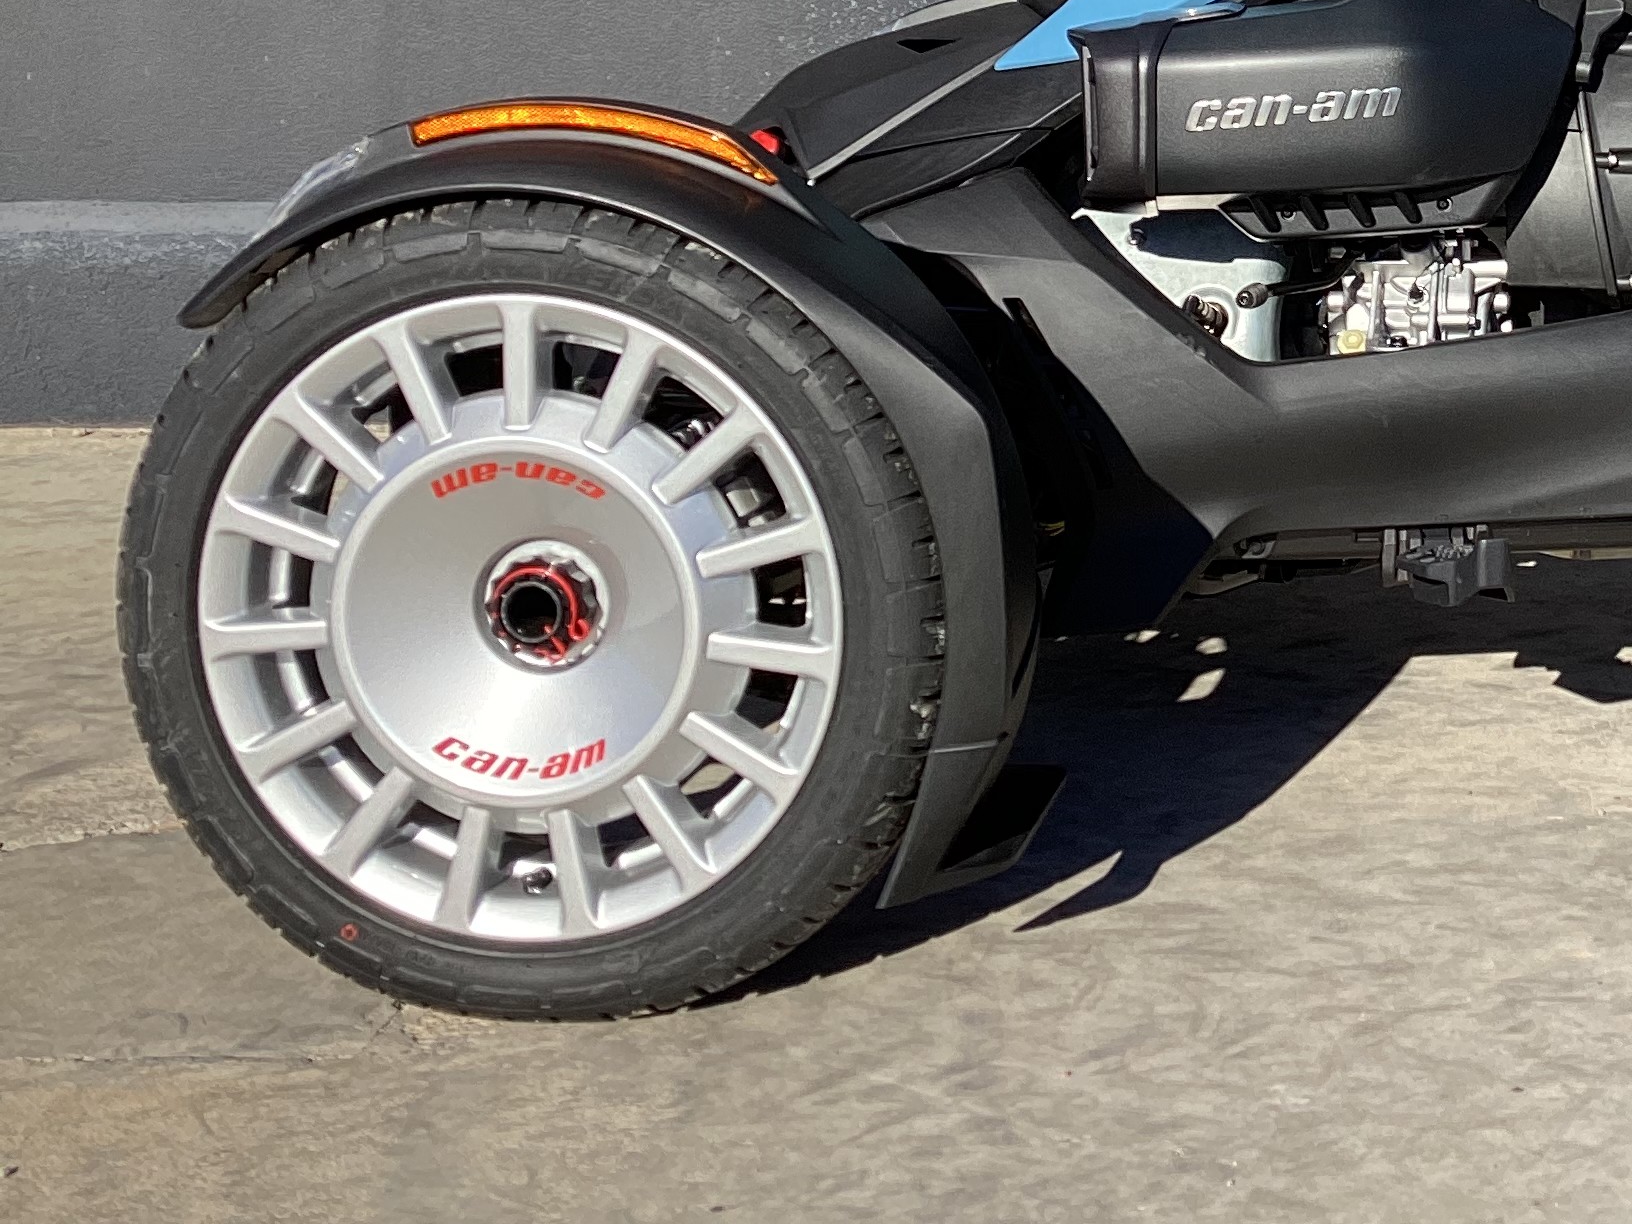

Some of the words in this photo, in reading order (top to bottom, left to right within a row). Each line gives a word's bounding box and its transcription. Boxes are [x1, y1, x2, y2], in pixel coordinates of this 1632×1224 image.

[1185, 86, 1402, 131] can-am
[431, 461, 606, 499] can-am
[432, 736, 606, 780] can-am
